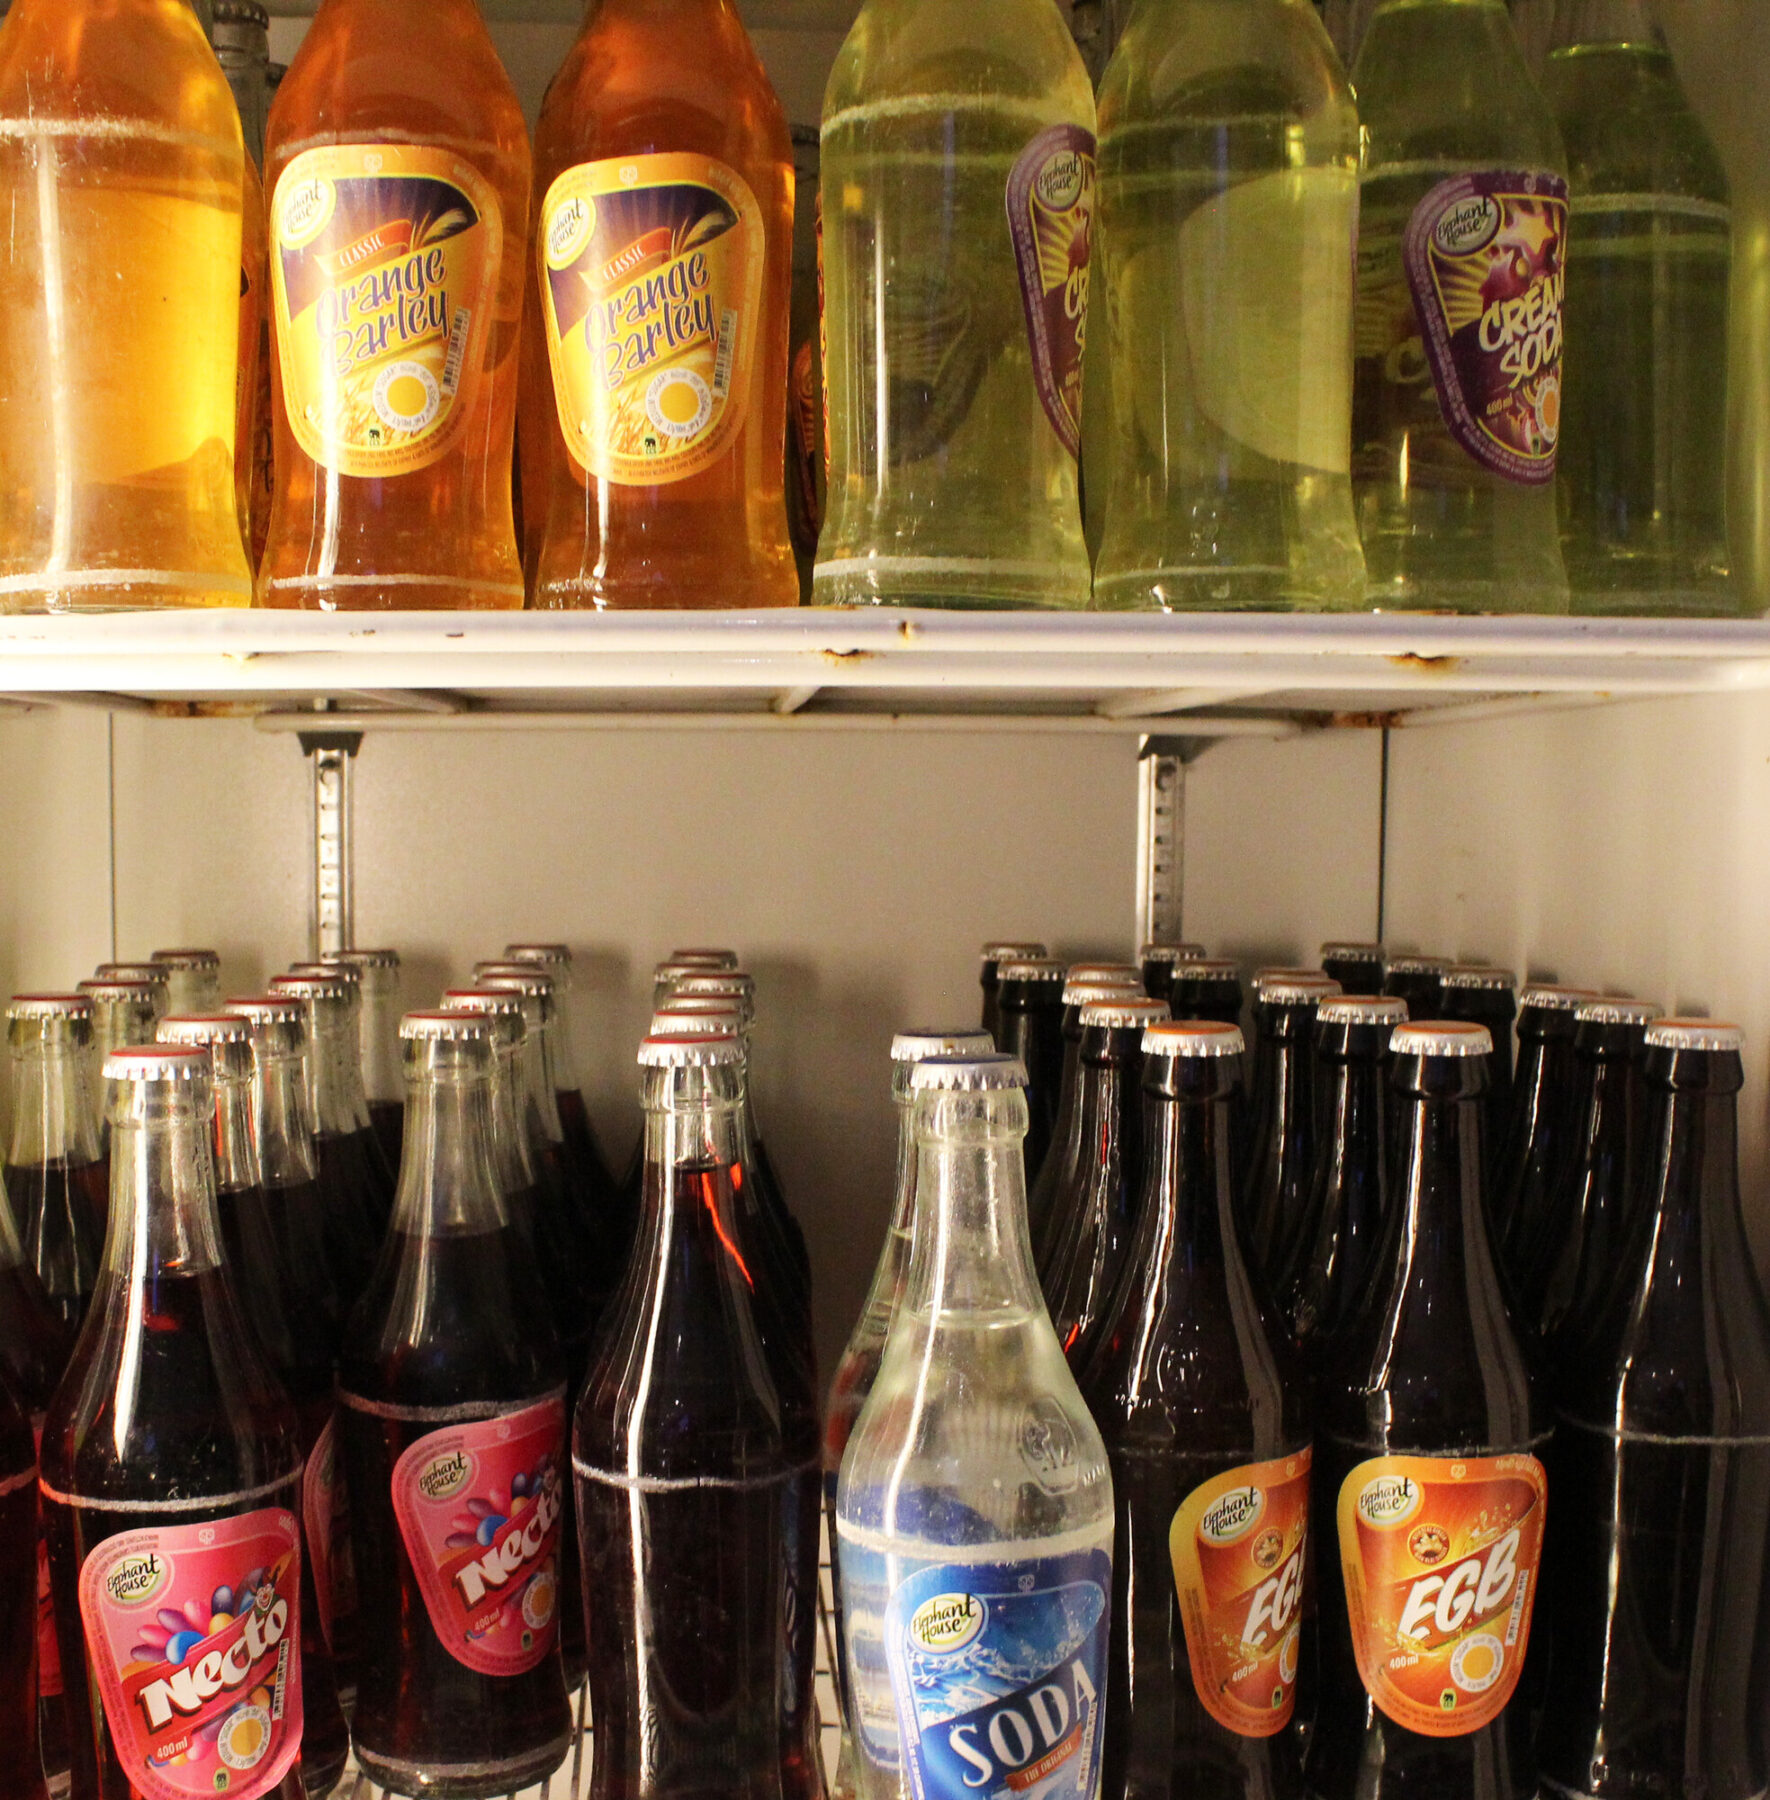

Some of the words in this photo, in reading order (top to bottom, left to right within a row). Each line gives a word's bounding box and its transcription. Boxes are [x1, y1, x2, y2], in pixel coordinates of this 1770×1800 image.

[1040, 151, 1079, 190] Elephant
[1046, 175, 1071, 200] House
[1438, 195, 1492, 239] Elephant
[1446, 218, 1481, 246] House
[340, 235, 384, 268] CLASSIC
[603, 245, 646, 280] CLASSIC
[316, 248, 445, 338] Orange
[585, 252, 708, 353] Orange
[322, 291, 447, 376] Barley
[595, 294, 716, 389] Barley
[419, 1451, 467, 1490] Elephant
[427, 1471, 457, 1496] House
[1204, 1486, 1257, 1530] Elephant
[1360, 1477, 1412, 1509] Elephant
[1367, 1497, 1400, 1518] House
[1212, 1509, 1246, 1536] House
[107, 1553, 160, 1592] Elephant
[115, 1575, 148, 1600] House
[1397, 1529, 1519, 1643] EGB
[913, 1593, 976, 1632] Elephant
[922, 1617, 962, 1644] House
[139, 1598, 288, 1728] Necto
[949, 1659, 1097, 1788] SODA
